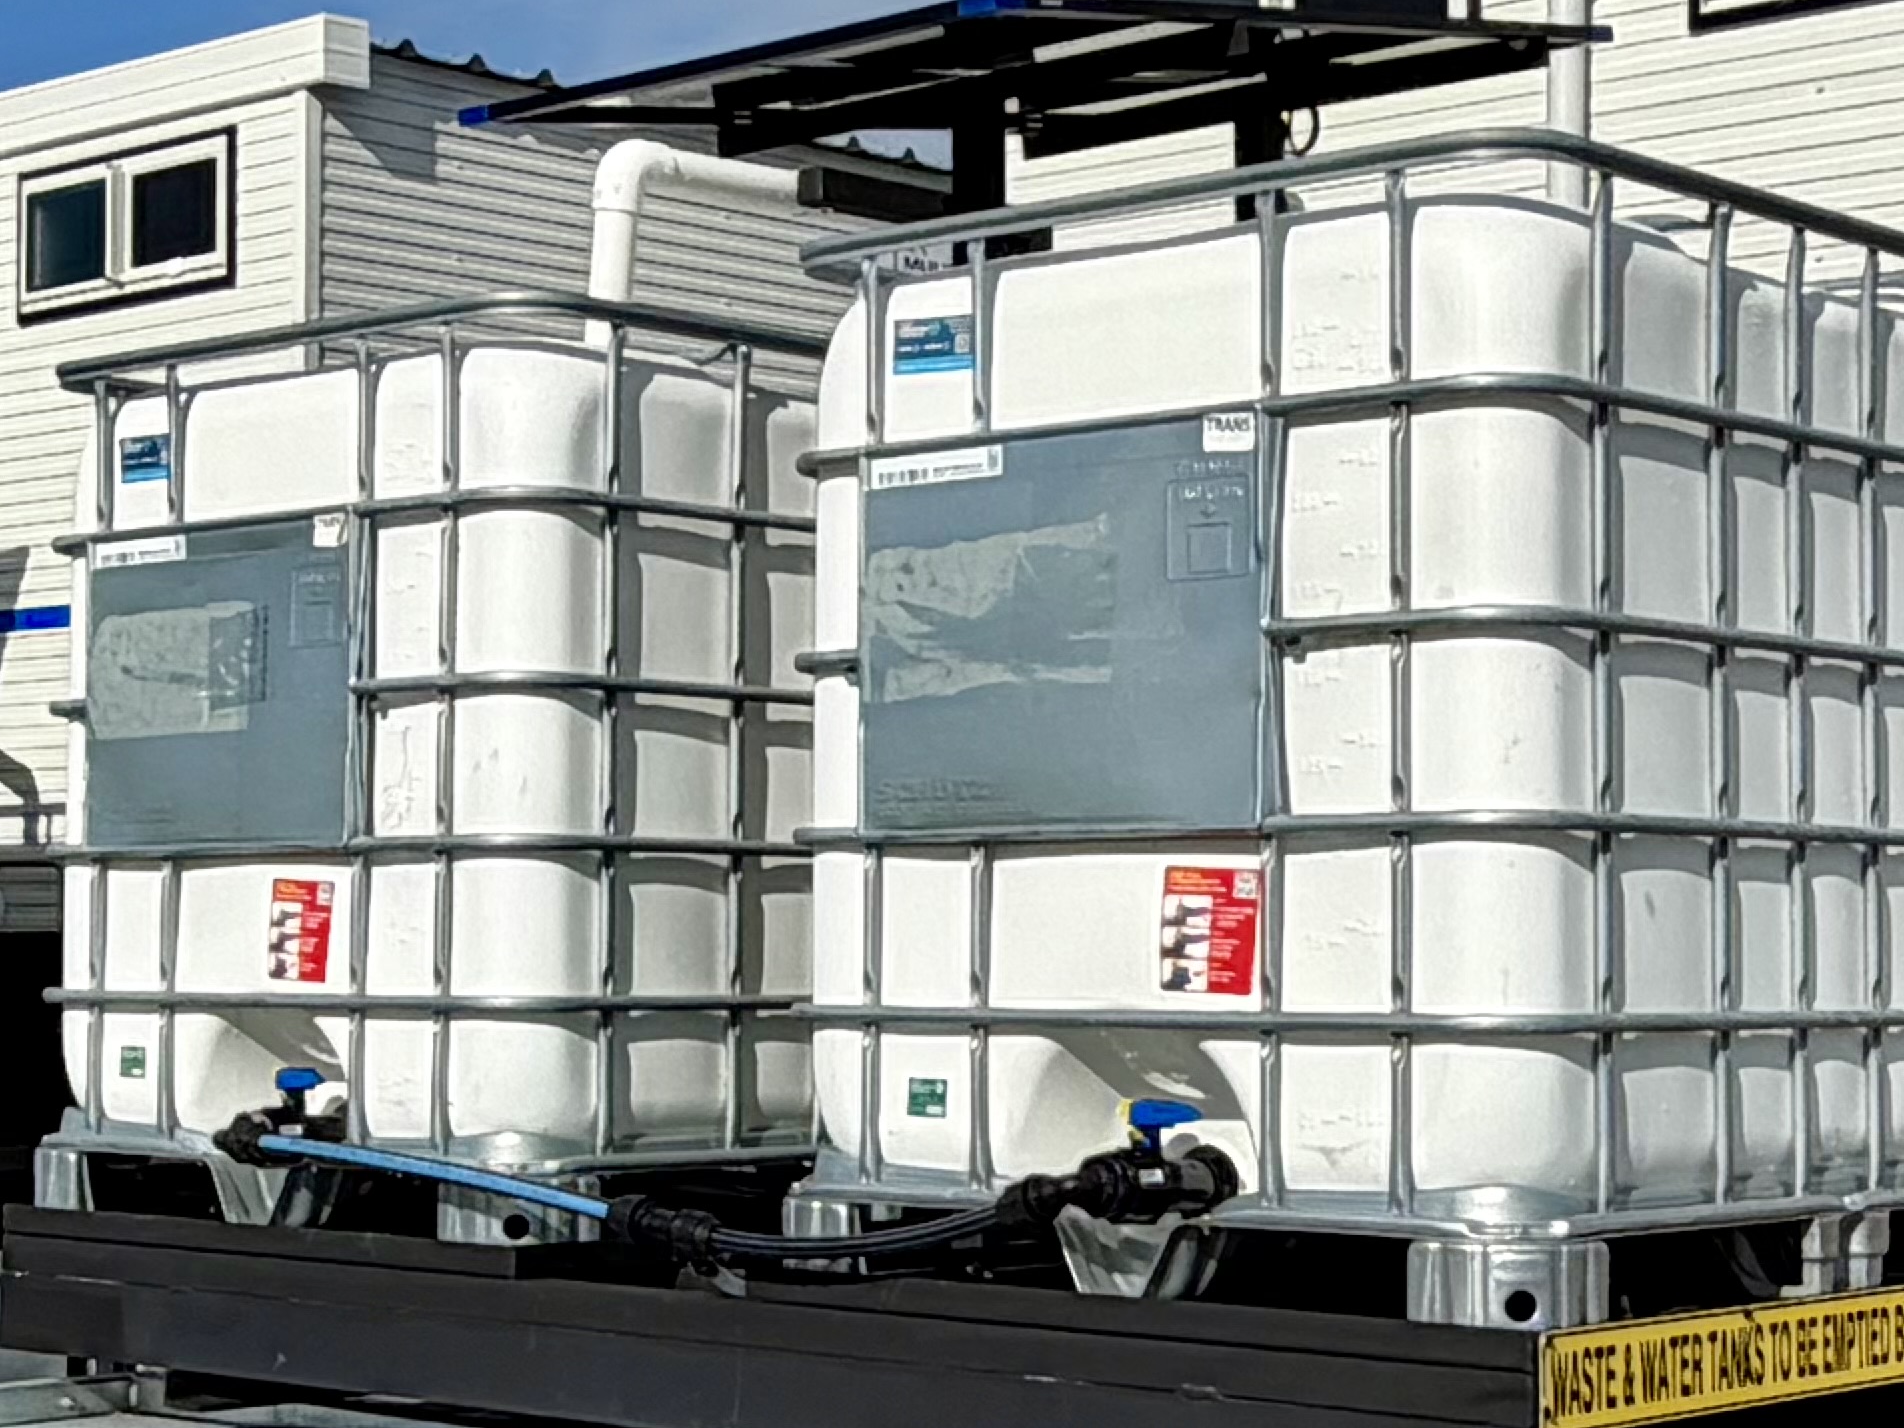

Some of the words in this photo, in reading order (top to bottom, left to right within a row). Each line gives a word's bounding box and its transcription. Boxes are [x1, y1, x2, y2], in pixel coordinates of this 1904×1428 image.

[1551, 1344, 1617, 1418] WASTE
[1623, 1342, 1635, 1406] &
[1639, 1332, 1703, 1404] WATER
[1707, 1323, 1765, 1393] TANKS
[1769, 1319, 1791, 1384] TO
[1797, 1316, 1819, 1378] BE
[1823, 1306, 1890, 1373] EMPTIED
